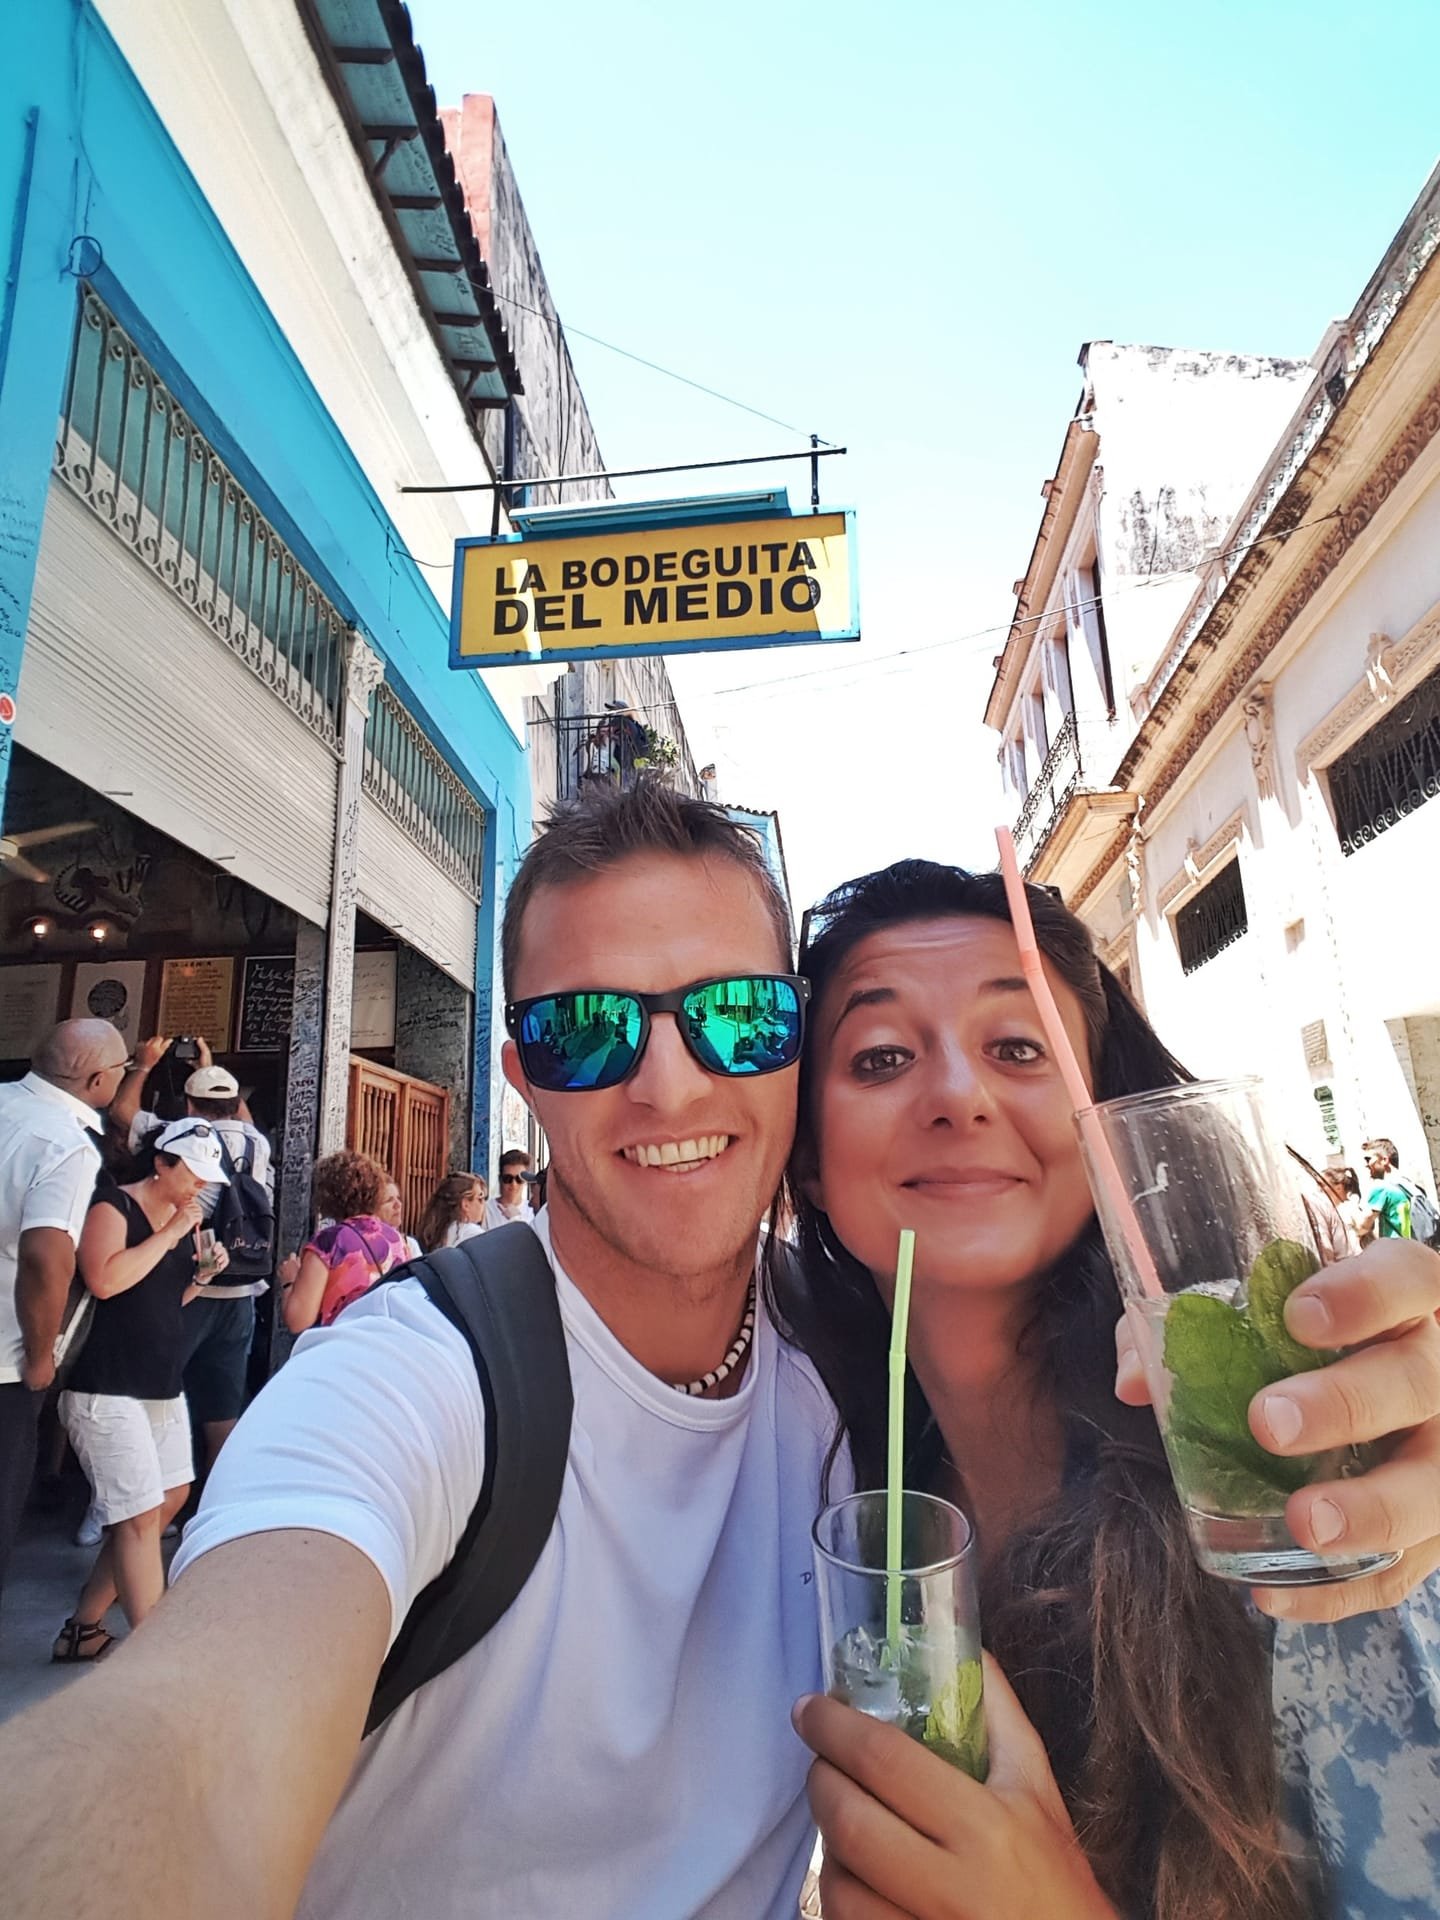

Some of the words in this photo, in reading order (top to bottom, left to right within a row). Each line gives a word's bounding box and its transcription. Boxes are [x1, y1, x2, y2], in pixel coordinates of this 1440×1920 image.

[495, 564, 547, 596] LA
[562, 541, 817, 591] BODEGUITA
[493, 593, 602, 636] DEL
[624, 574, 822, 626] MEDIO
